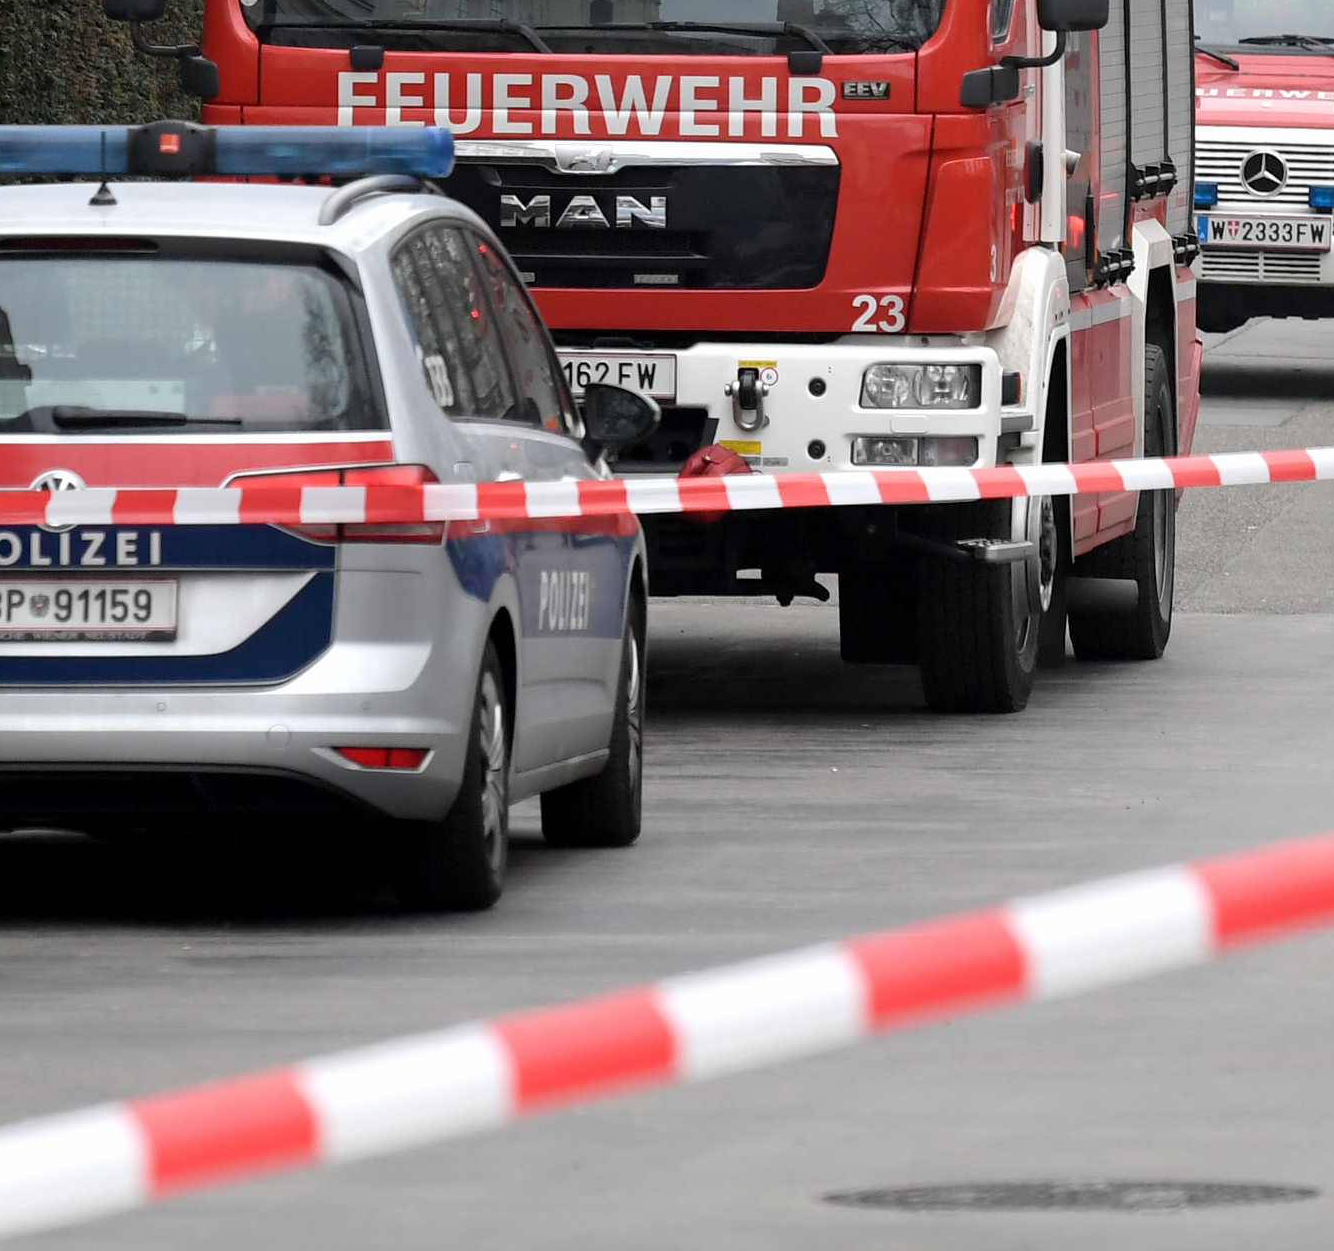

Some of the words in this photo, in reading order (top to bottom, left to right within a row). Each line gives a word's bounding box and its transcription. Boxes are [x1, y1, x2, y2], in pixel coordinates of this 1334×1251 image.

[338, 72, 838, 138] FEUERWEHR
[843, 82, 889, 97] EEV
[500, 195, 667, 228] MAN
[1212, 221, 1225, 240] W
[851, 294, 906, 333] 23
[564, 361, 610, 387] 162
[54, 589, 152, 623] 91159
[538, 571, 590, 631] POLIZEI
